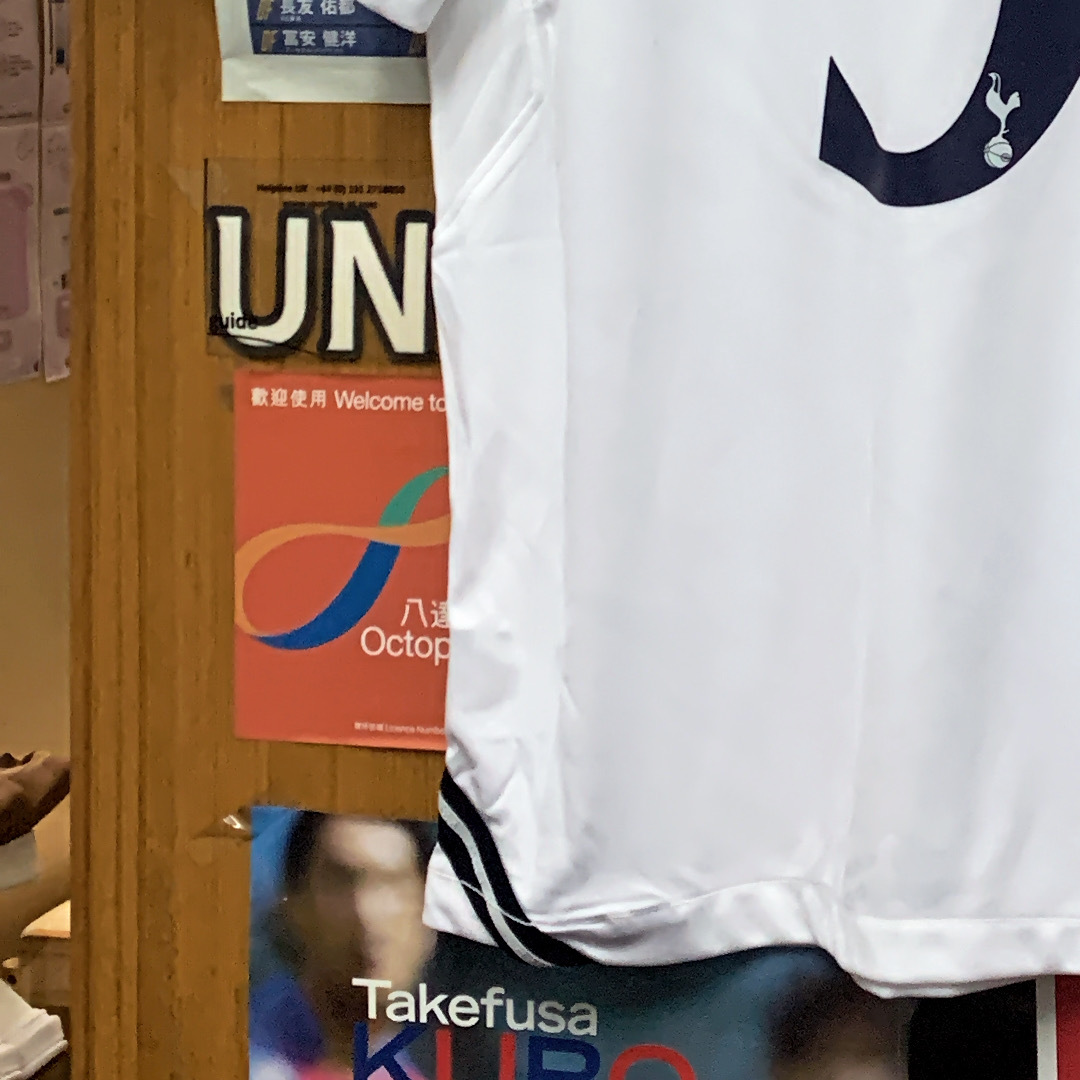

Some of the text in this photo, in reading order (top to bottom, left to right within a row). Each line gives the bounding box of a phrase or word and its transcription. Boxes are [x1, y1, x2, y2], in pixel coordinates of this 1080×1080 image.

[208, 206, 435, 361] UN
[251, 387, 446, 412] 歡迎使用 Welcome to
[360, 625, 450, 666] Octop
[352, 977, 598, 1037] Takefusa
